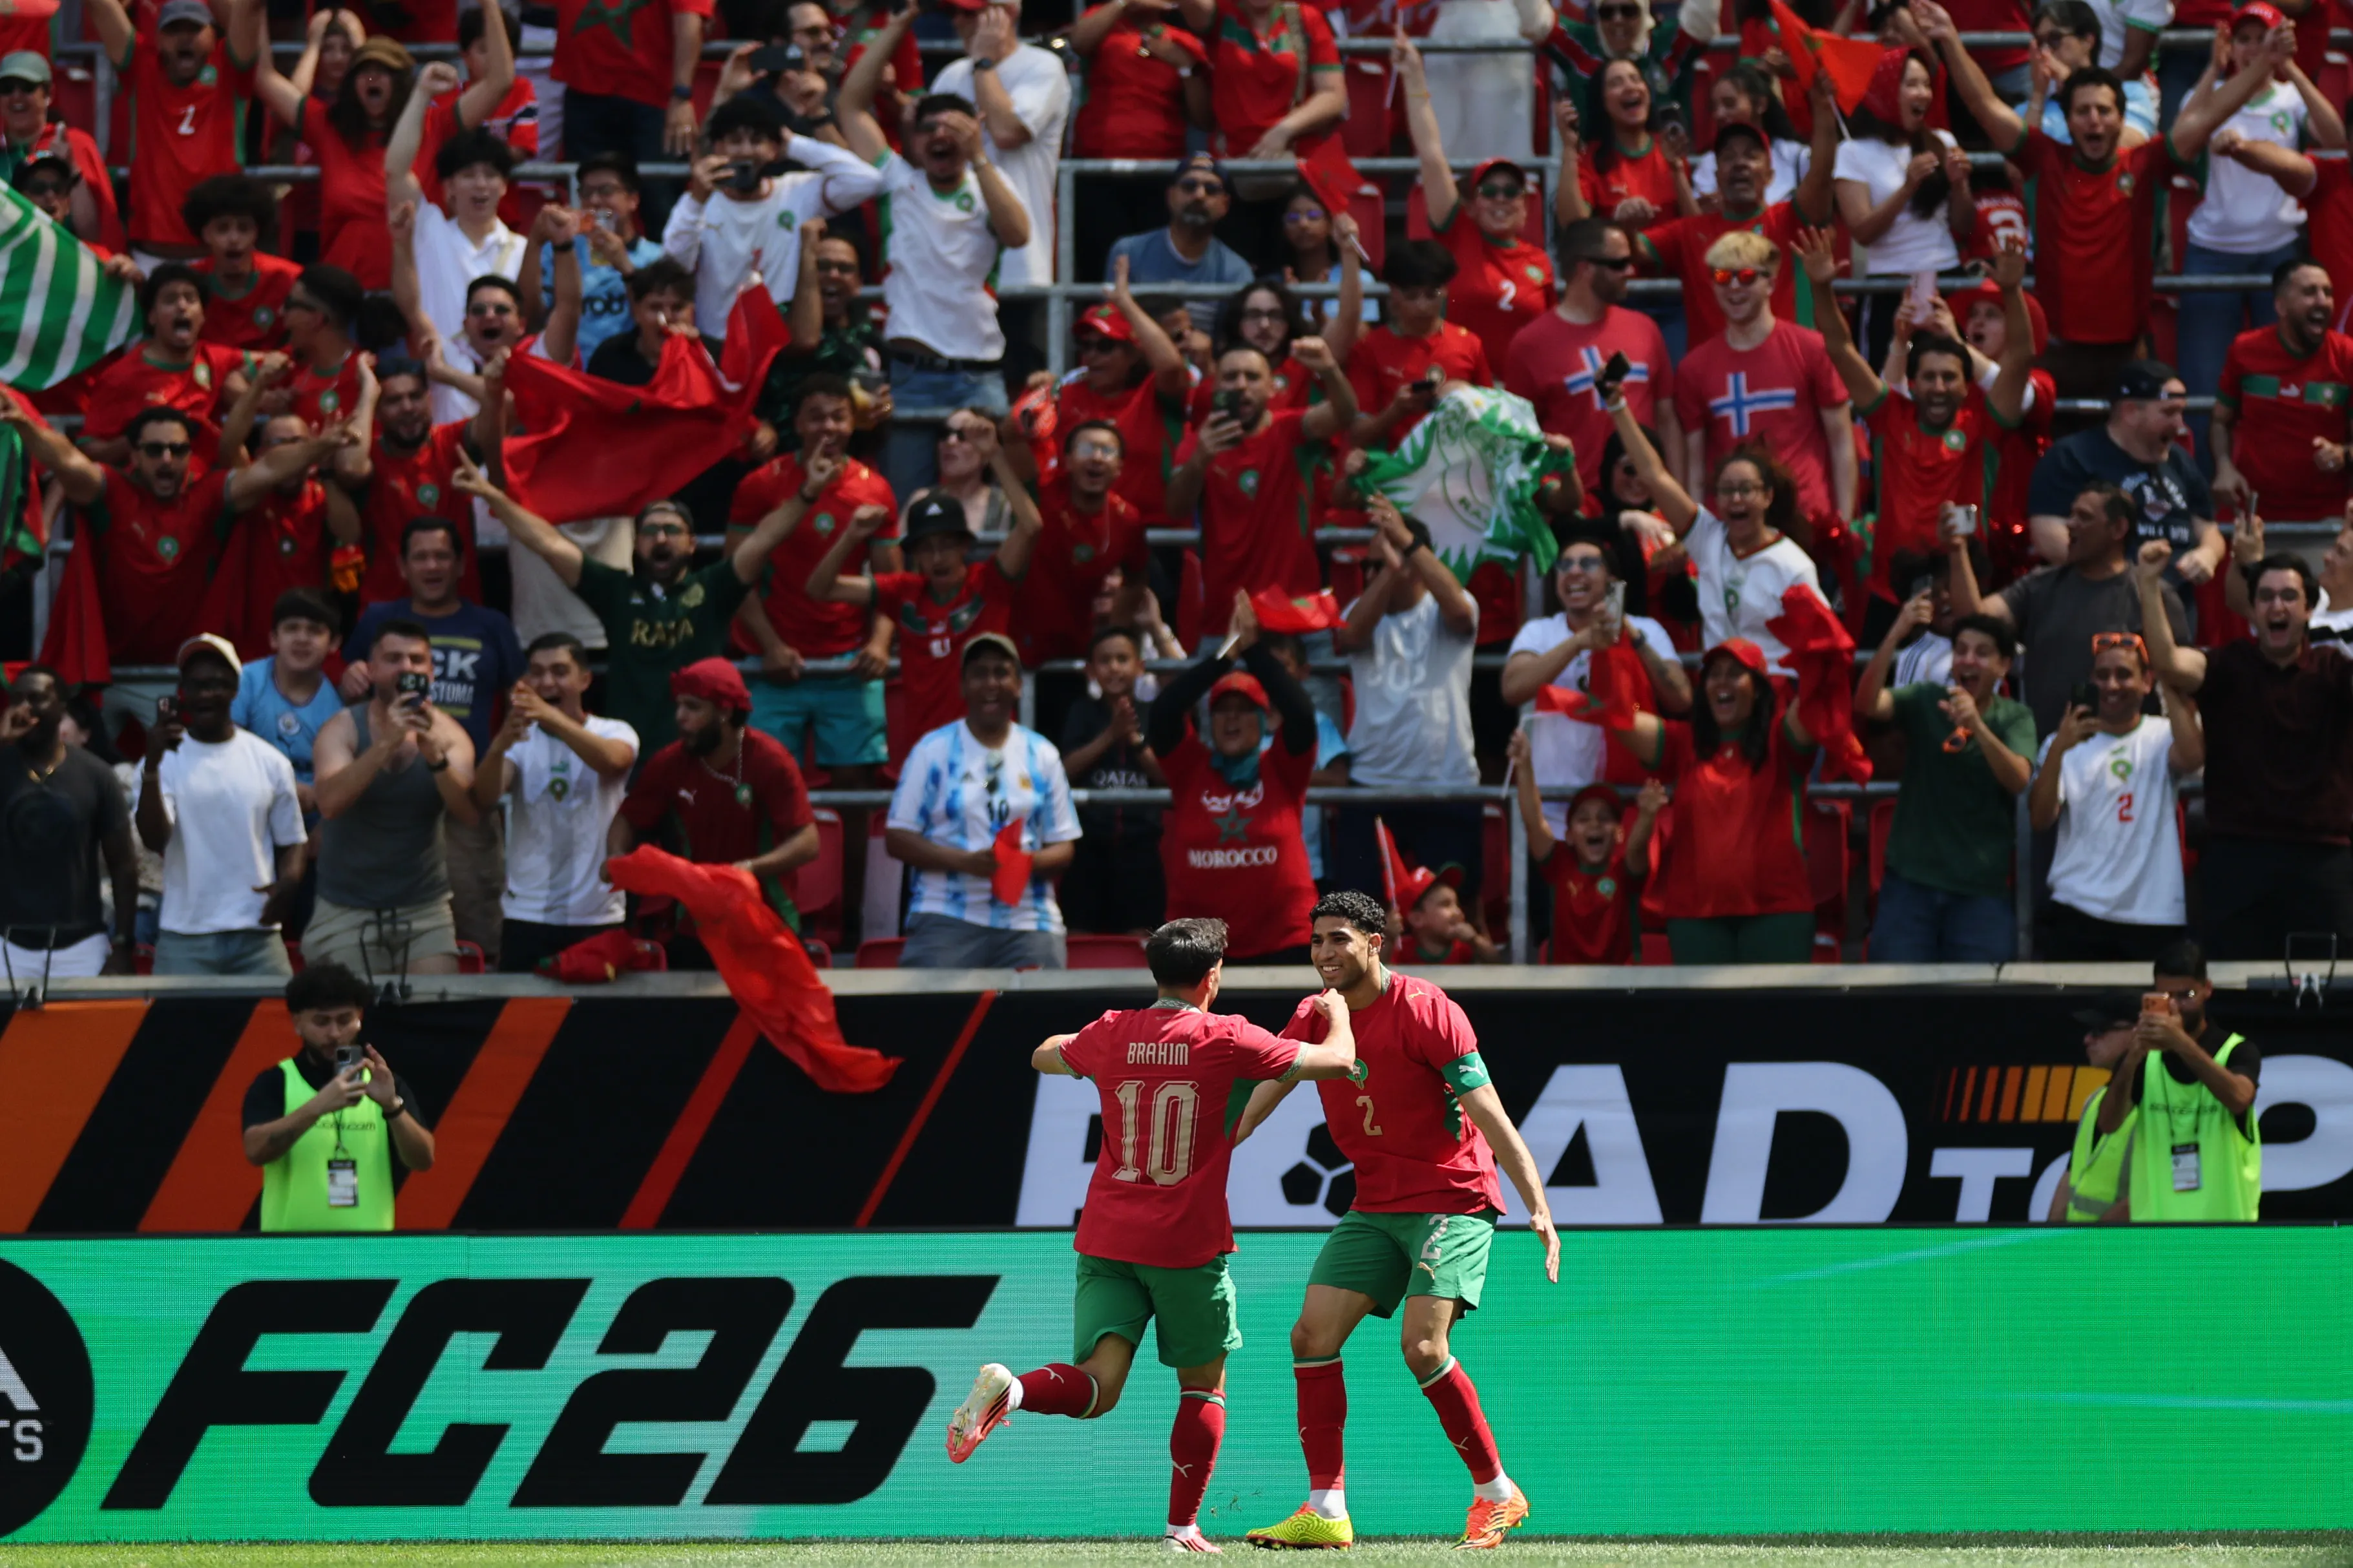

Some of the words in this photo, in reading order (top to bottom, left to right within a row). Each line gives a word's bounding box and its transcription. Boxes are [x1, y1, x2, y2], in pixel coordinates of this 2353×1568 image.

[1498, 279, 1516, 311] 2
[2118, 793, 2134, 821] 2
[1189, 846, 1277, 868] MOROCCO
[1127, 1042, 1189, 1065] BRAHIM
[1112, 1080, 1200, 1187] 10
[1356, 1095, 1383, 1136] 2
[1421, 1214, 1448, 1259] 2
[99, 1274, 1002, 1510] FC26
